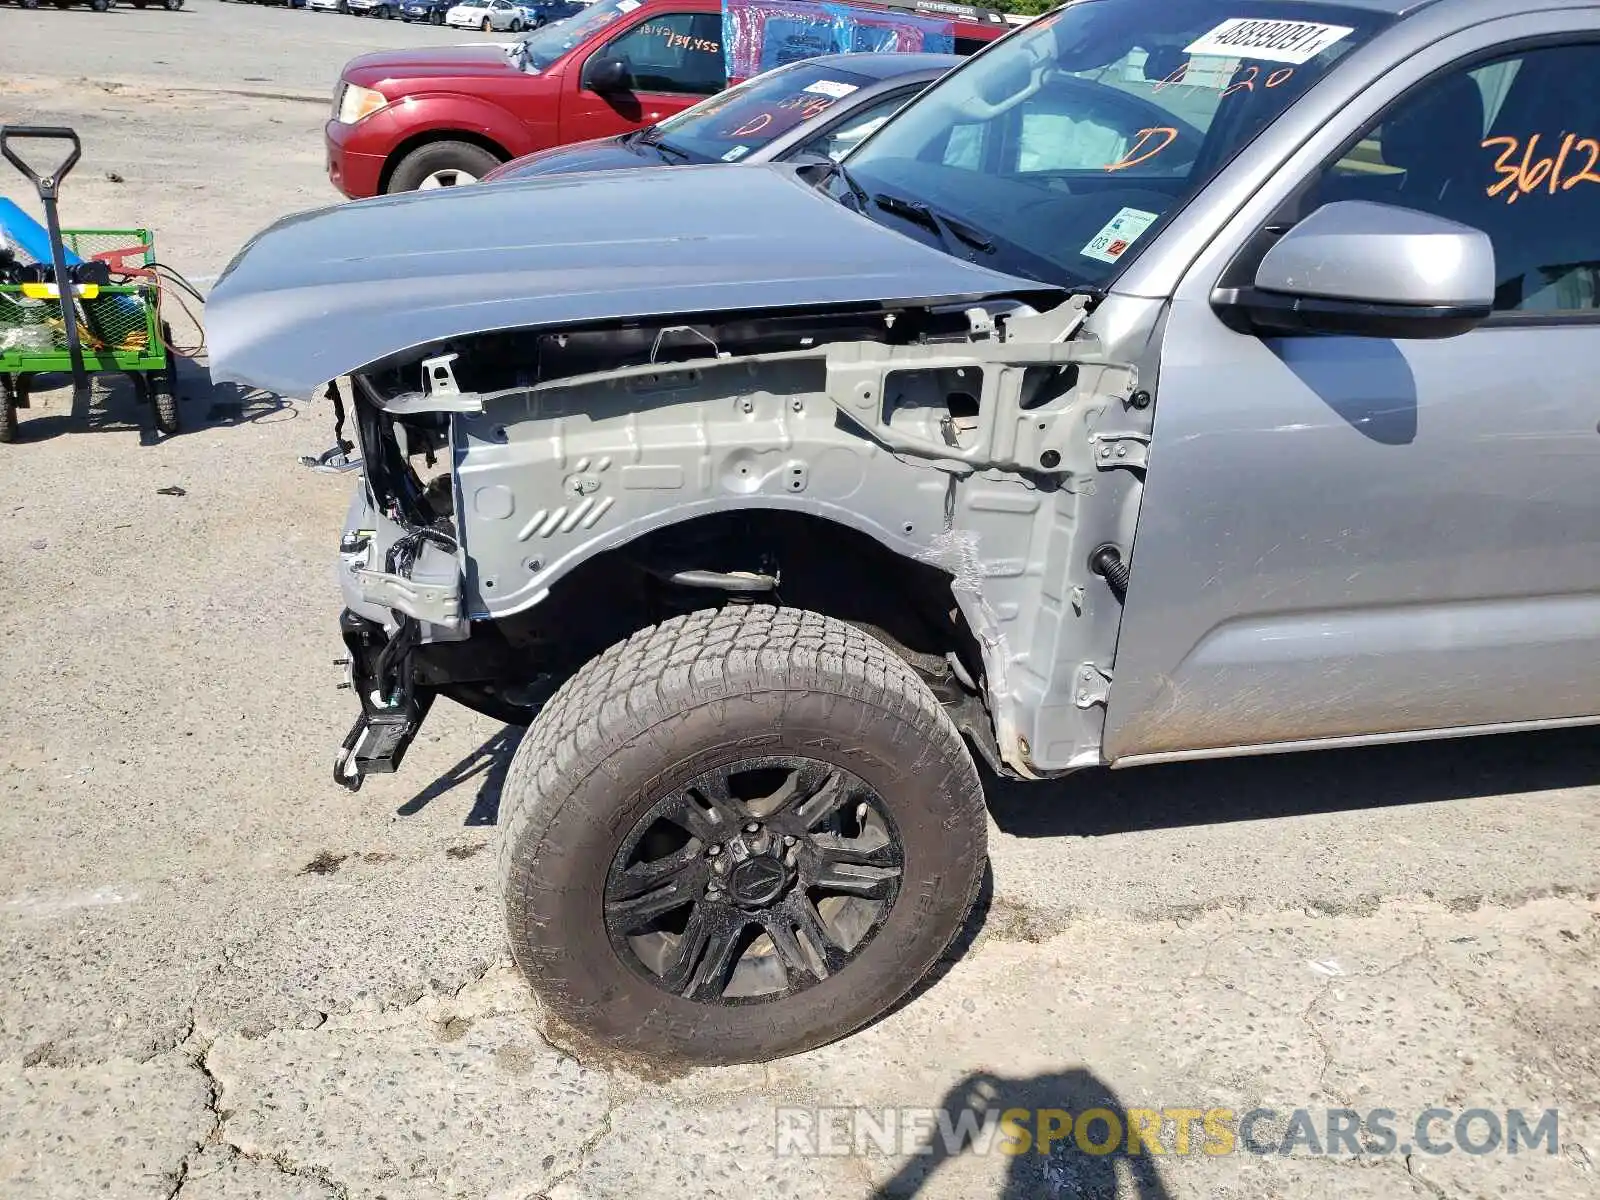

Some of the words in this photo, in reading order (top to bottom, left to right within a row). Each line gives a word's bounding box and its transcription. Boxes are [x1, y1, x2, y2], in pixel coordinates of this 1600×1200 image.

[916, 1, 975, 15] PATHFINDER
[1104, 127, 1179, 173] D
[1091, 236, 1109, 250] 03
[1105, 240, 1128, 255] 22
